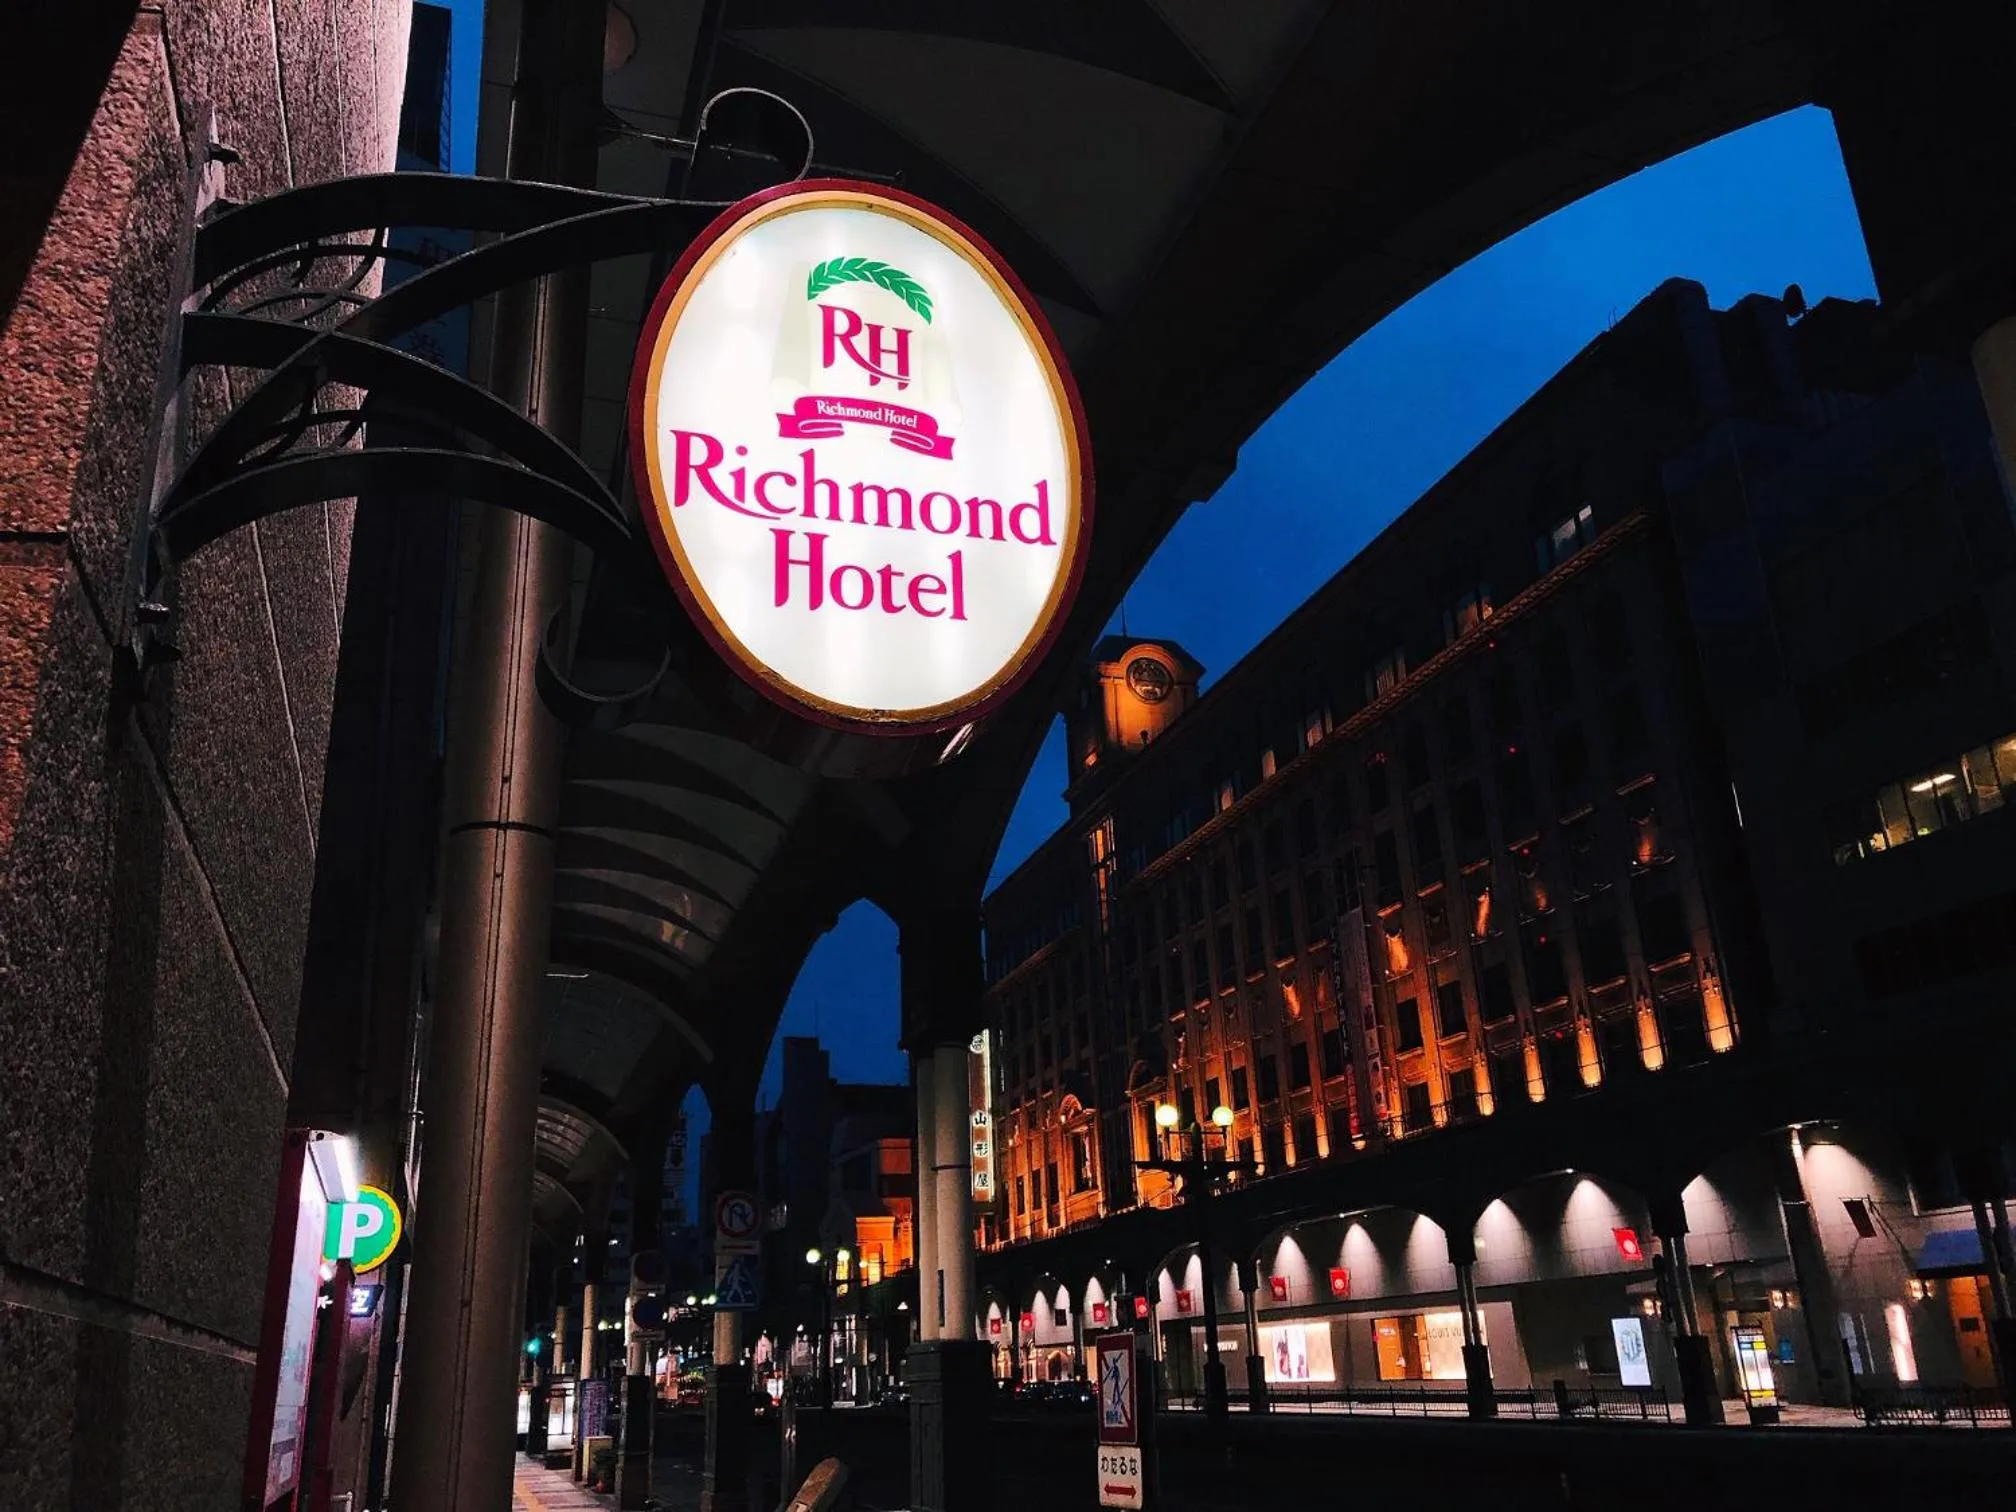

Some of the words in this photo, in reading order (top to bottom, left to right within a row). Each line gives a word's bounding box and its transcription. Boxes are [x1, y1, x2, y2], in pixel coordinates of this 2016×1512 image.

[817, 304, 913, 390] RH
[816, 400, 882, 421] Richmond
[884, 408, 918, 428] Hotel
[669, 429, 1057, 546] Richmond
[769, 527, 968, 621] Hotel
[974, 1112, 988, 1188] 山形屋
[337, 1202, 384, 1260] P
[1101, 1456, 1138, 1476] わたるな
